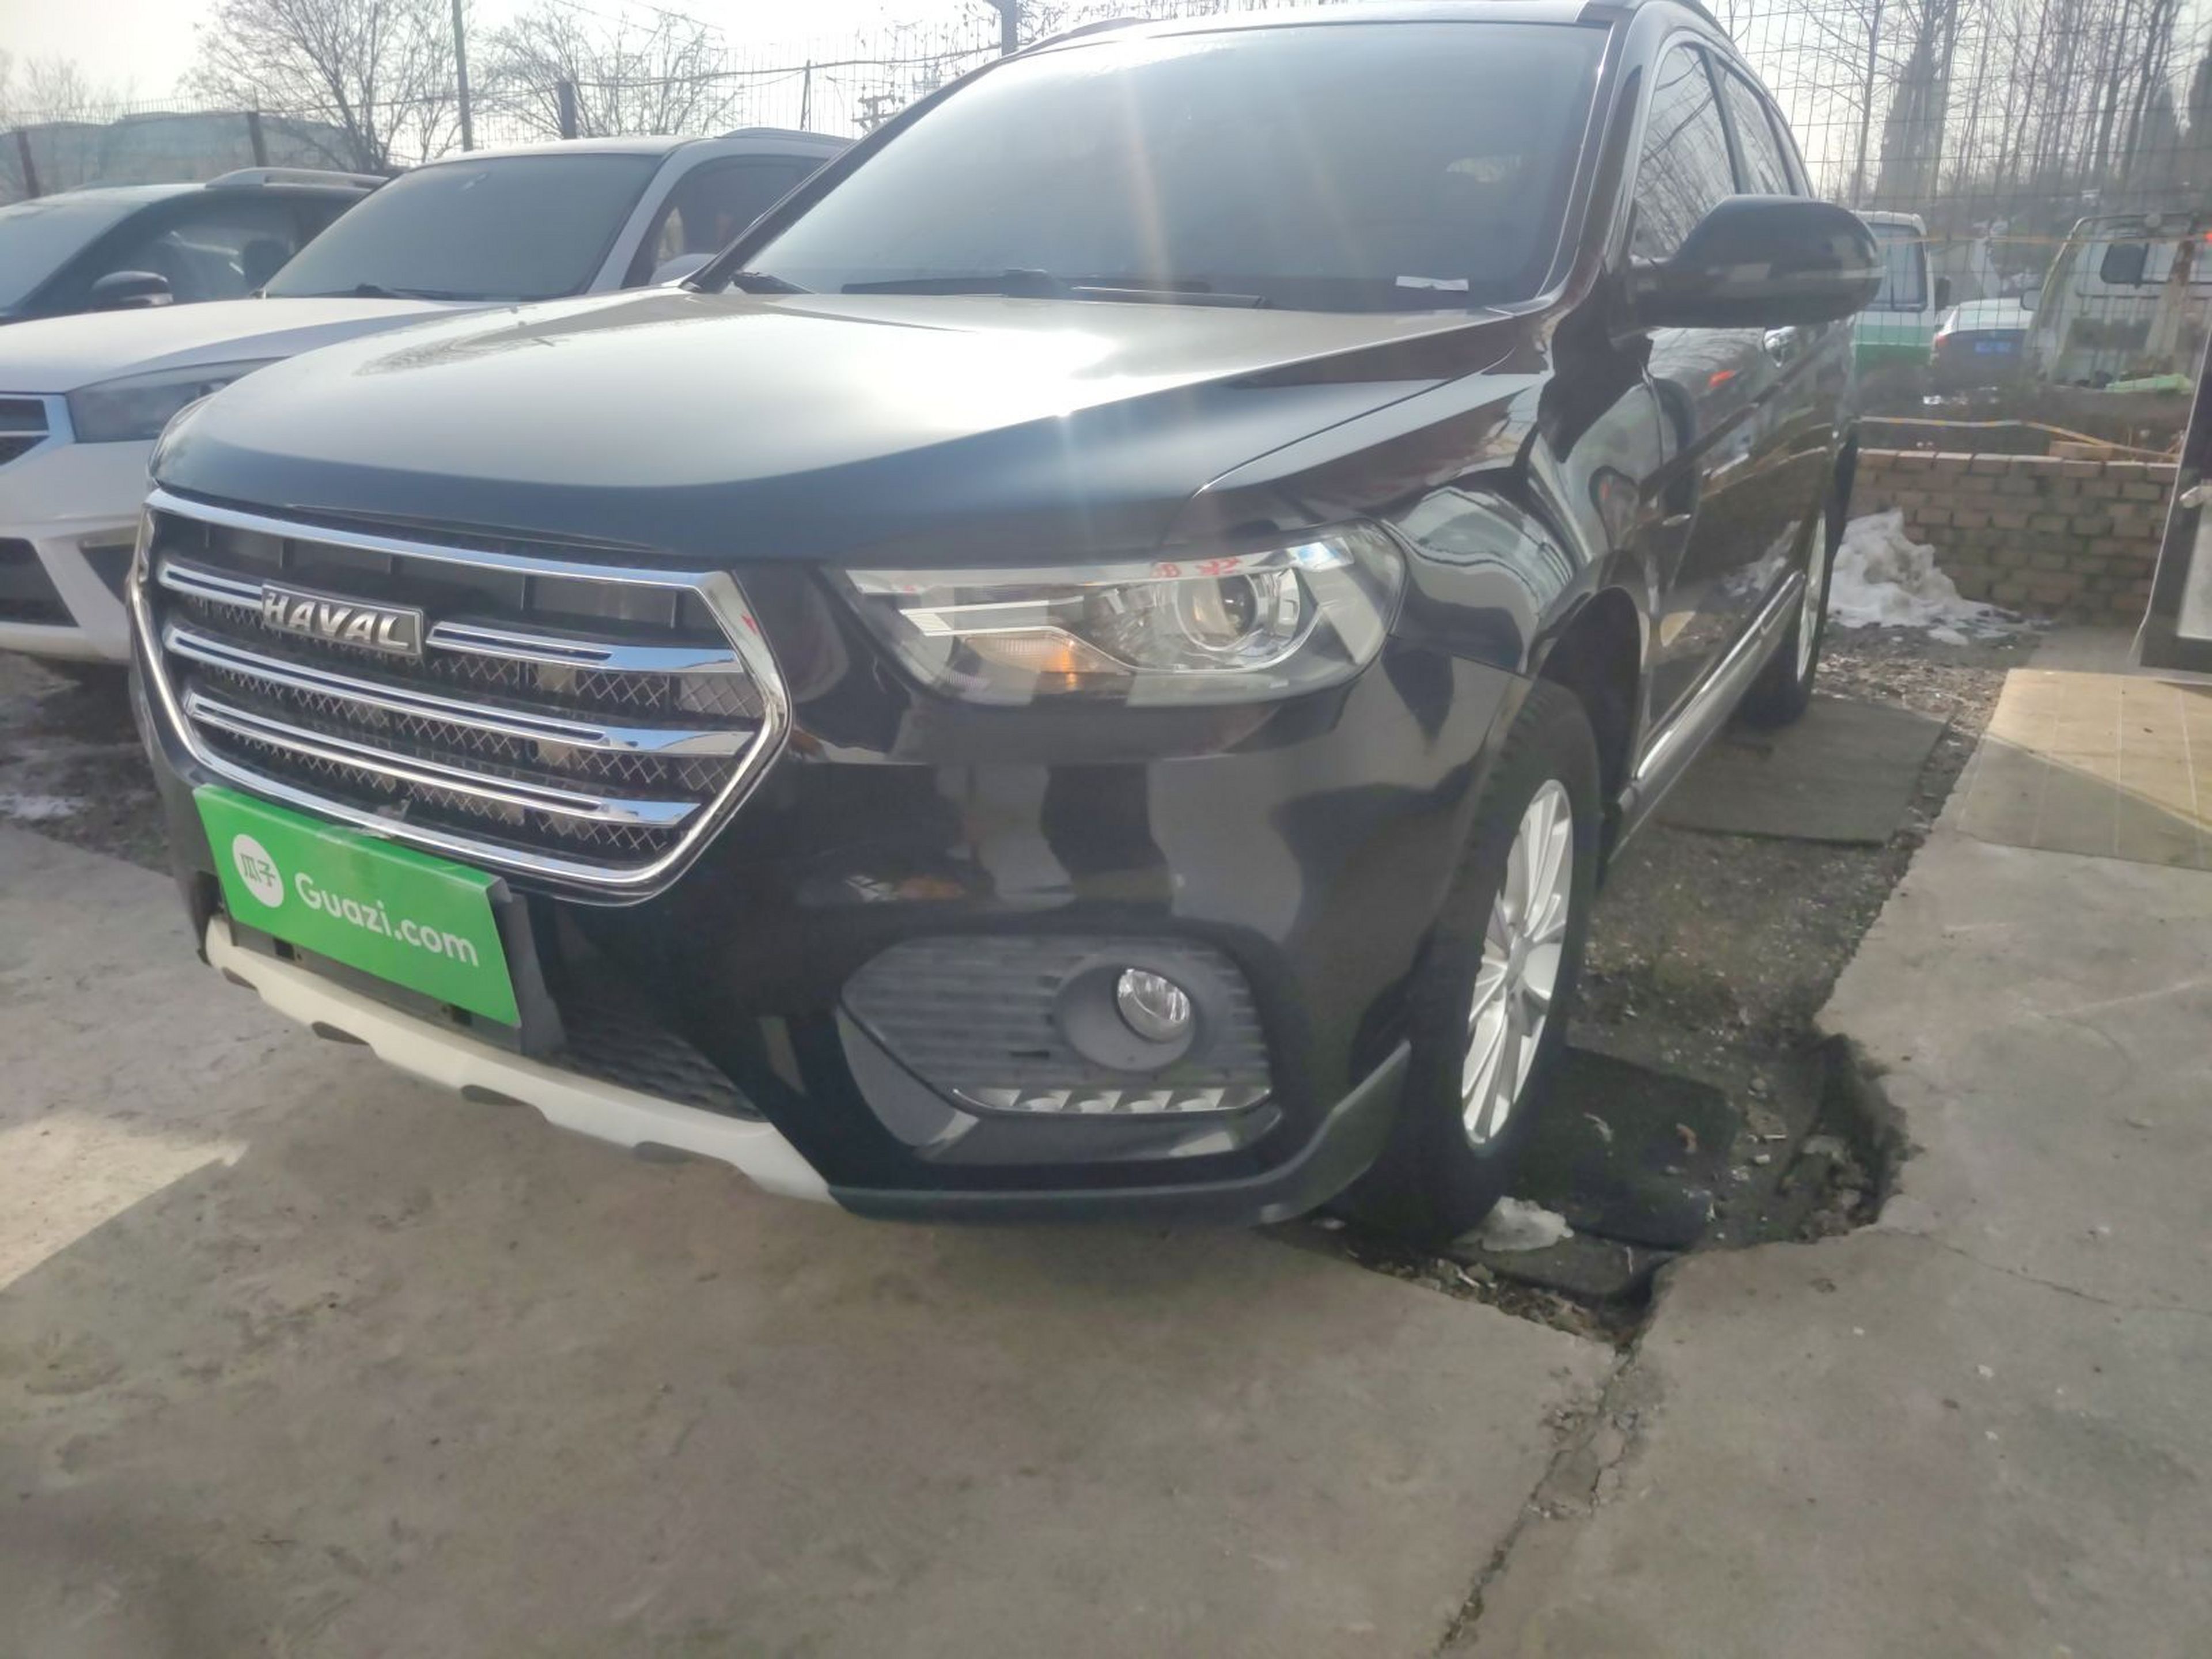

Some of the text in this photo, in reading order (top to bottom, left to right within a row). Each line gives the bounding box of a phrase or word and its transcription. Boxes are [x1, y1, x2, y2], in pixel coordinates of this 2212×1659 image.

[263, 592, 408, 650] HAVAL
[239, 853, 275, 888] 瓜子
[294, 872, 480, 968] Guazi.com
